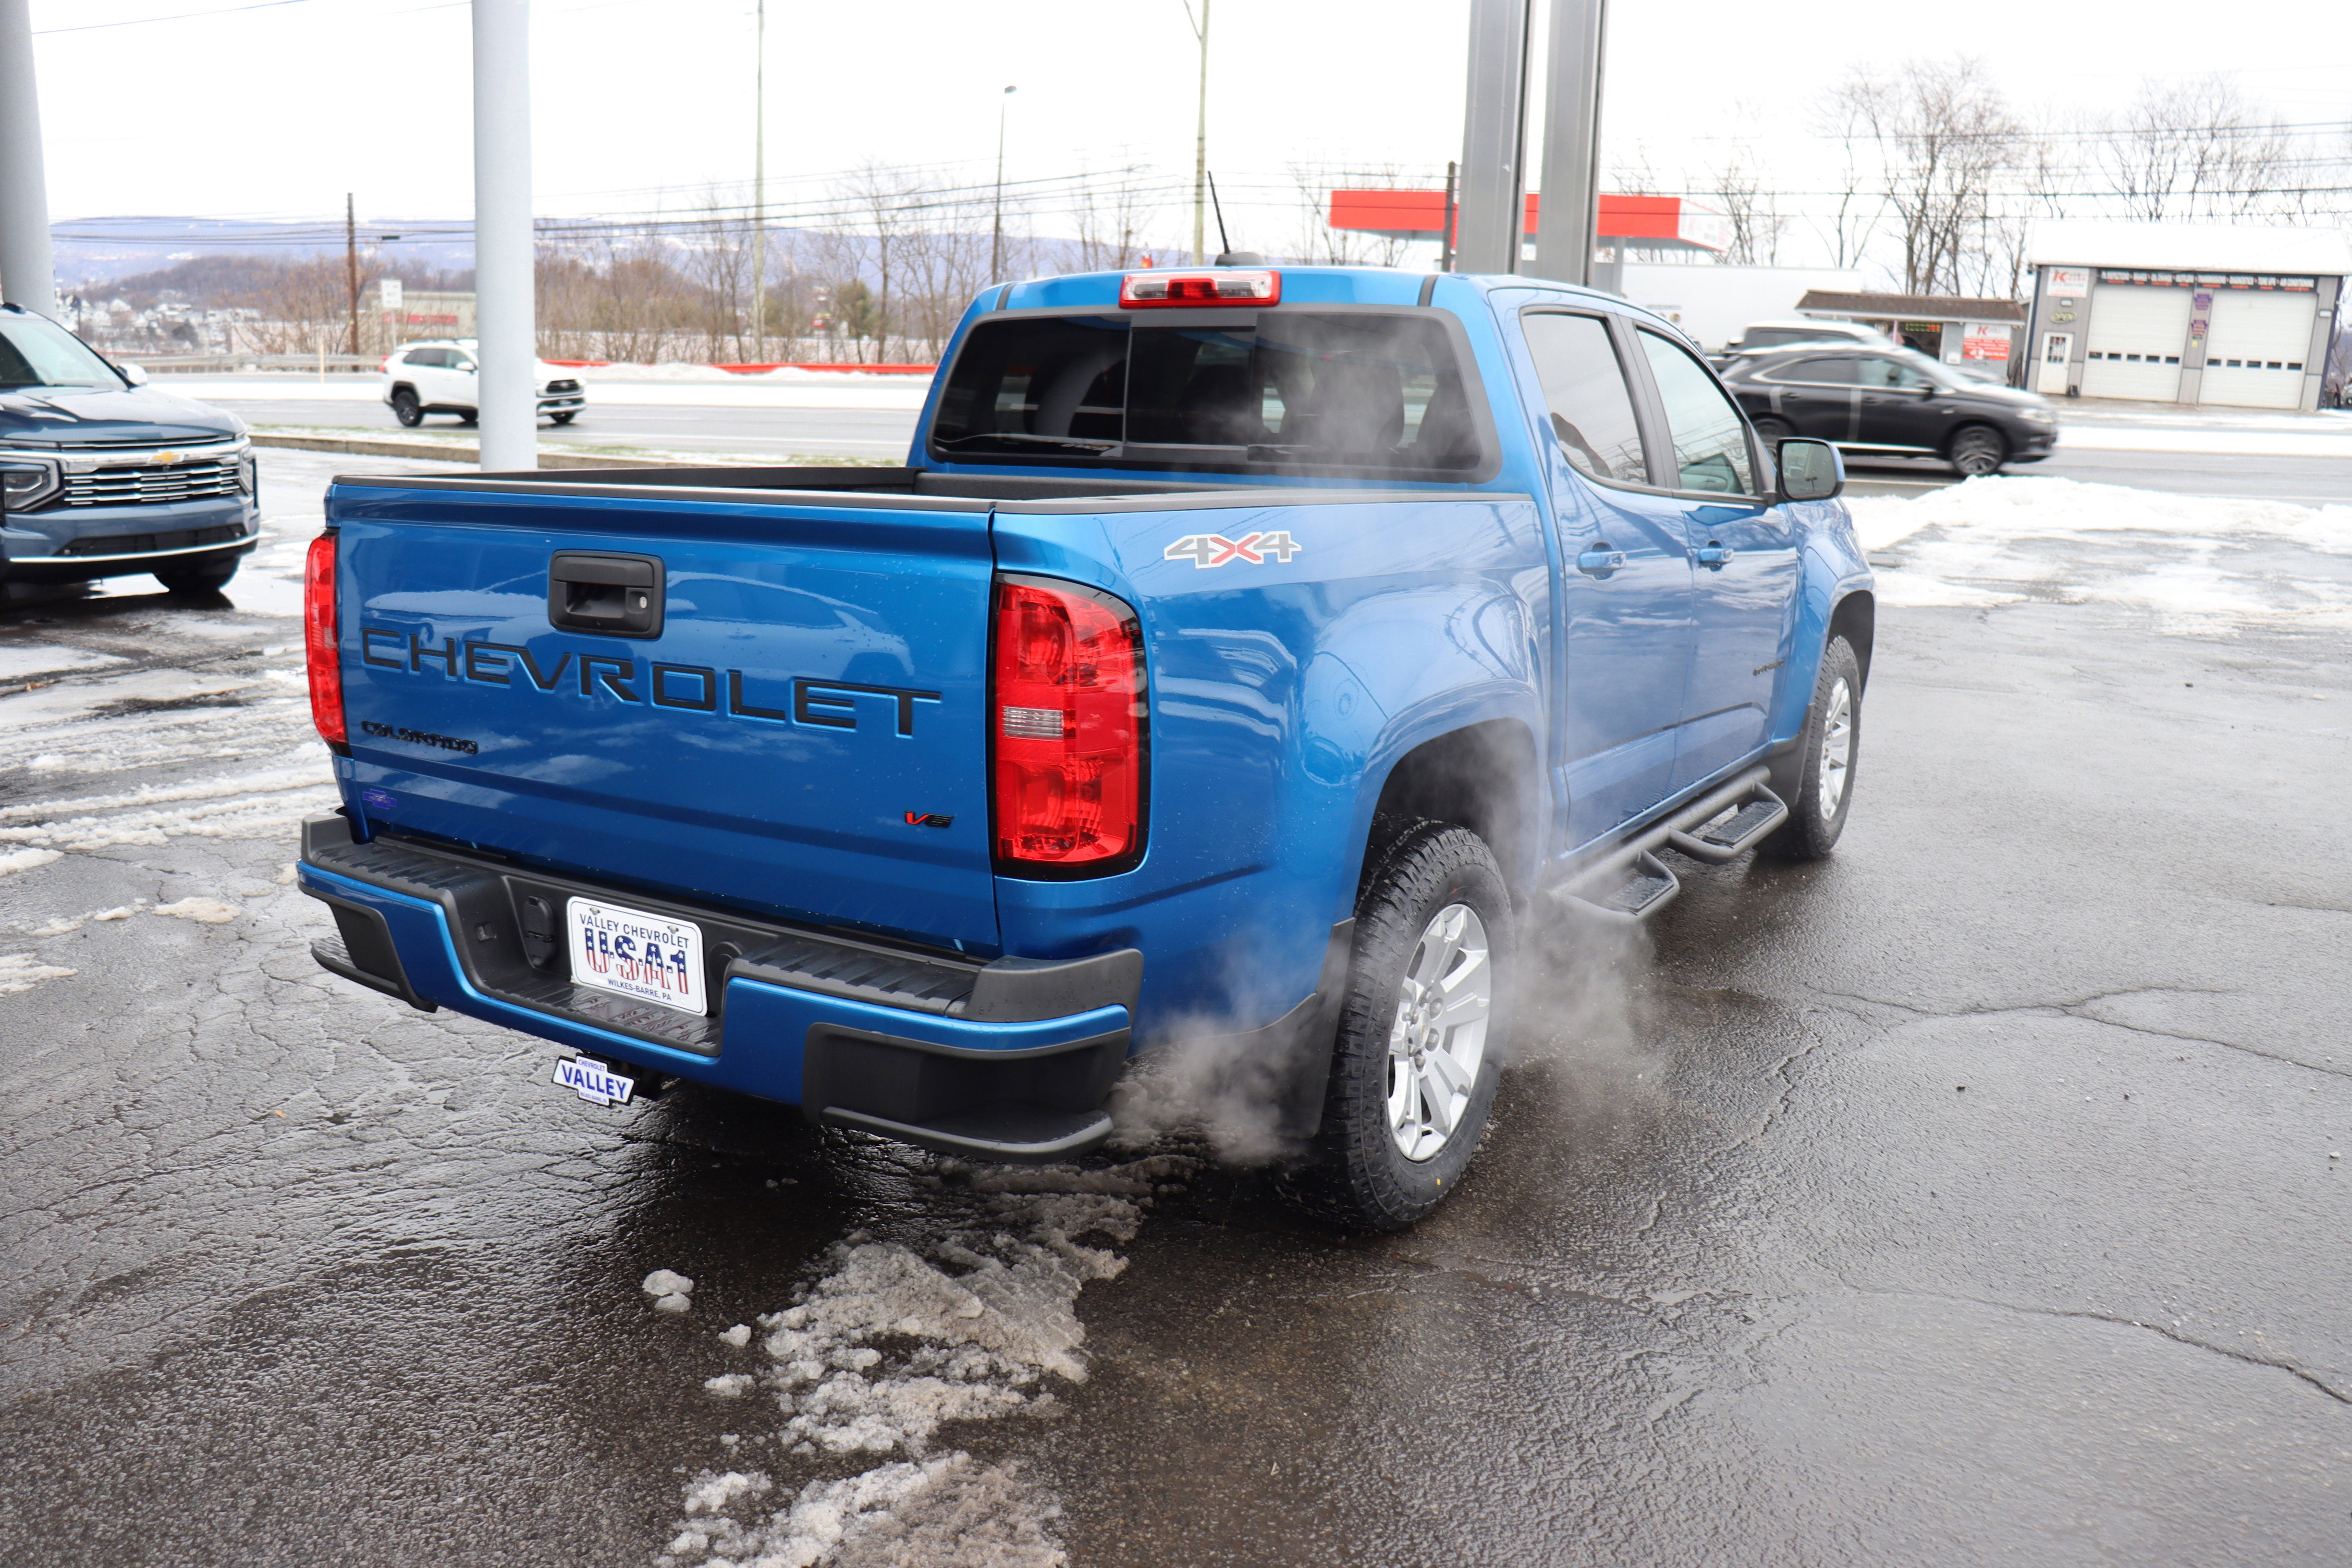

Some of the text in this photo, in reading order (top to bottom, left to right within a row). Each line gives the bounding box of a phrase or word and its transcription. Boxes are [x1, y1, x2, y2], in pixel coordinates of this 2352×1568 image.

[361, 626, 943, 739] CHEVROLET
[361, 720, 479, 755] COLORADO
[904, 811, 953, 828] V6
[579, 913, 689, 949] VALLEY CHEVROLET
[607, 978, 672, 1001] WILKES-BARRE, PA
[561, 1064, 627, 1099] VALLEY
[578, 1059, 606, 1071] CHEVROLET
